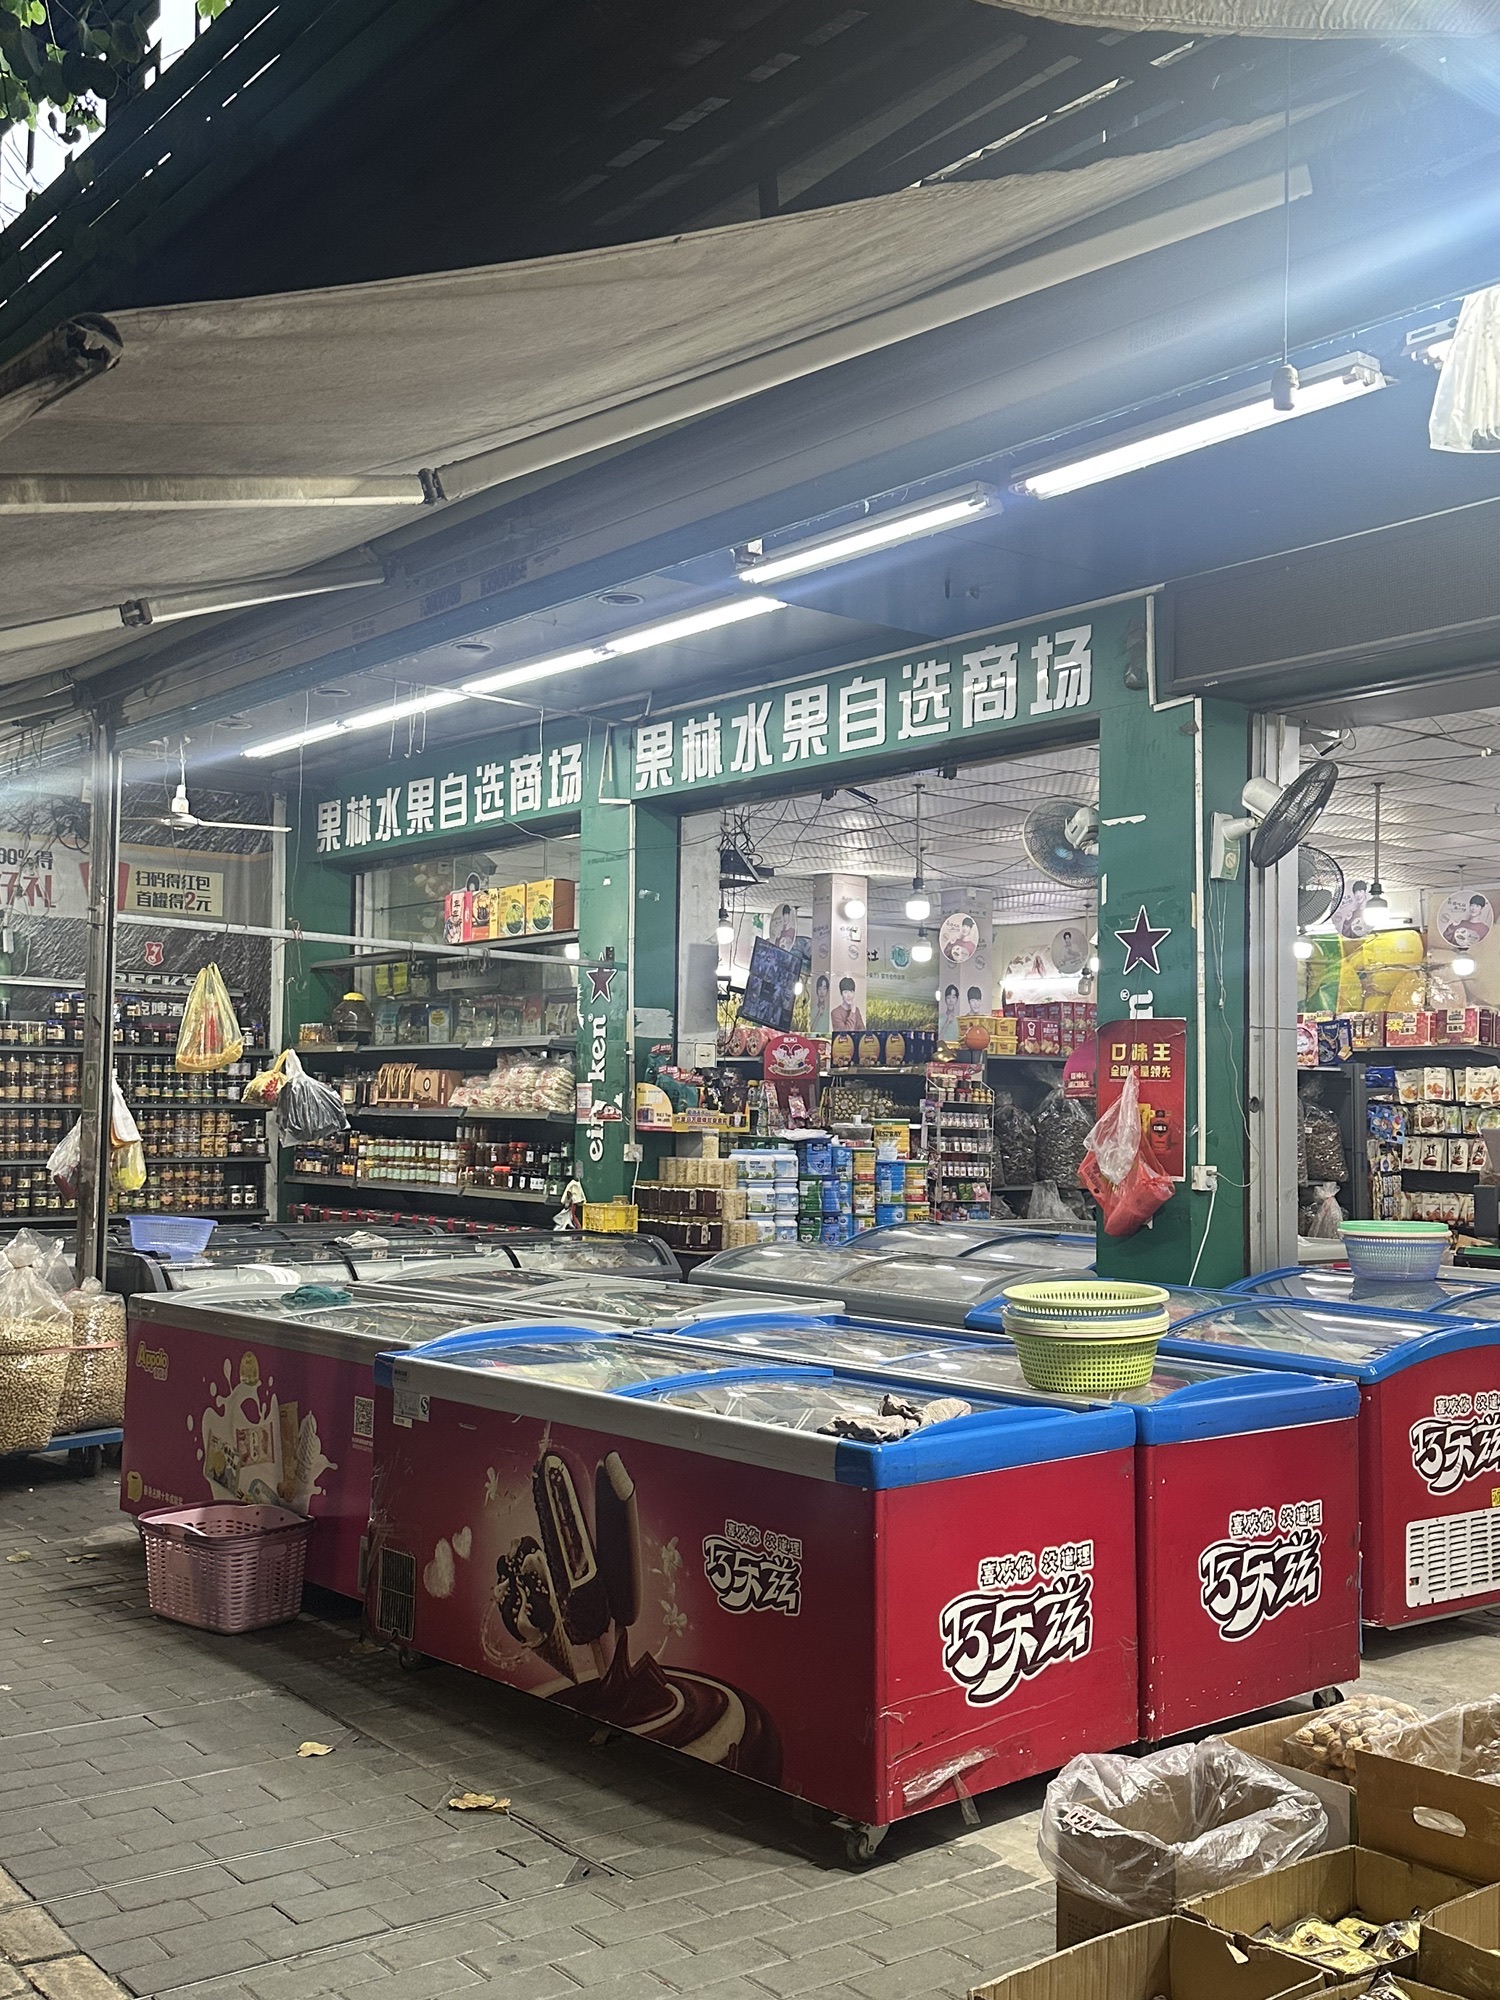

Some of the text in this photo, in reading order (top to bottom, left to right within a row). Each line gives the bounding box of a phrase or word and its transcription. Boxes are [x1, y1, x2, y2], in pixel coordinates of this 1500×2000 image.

[634, 623, 1095, 791] 果林水果自选商场
[317, 743, 583, 853] 果林水果自选商场
[135, 870, 211, 891] 扫码得红包
[136, 891, 212, 912] 首罐得2元
[1111, 1043, 1172, 1062] 口味王
[1110, 1065, 1172, 1079] 全国量领先
[136, 1342, 168, 1372] Appolo
[1436, 1394, 1500, 1415] 喜欢你 没道
[1411, 1415, 1500, 1492] 巧乐兹
[1231, 1502, 1321, 1537] 喜欢你 没道理
[725, 1521, 801, 1557] 喜欢你 没道理
[704, 1537, 800, 1614] 巧乐兹
[980, 1543, 1093, 1587] 喜欢你 没道理
[1201, 1529, 1320, 1638] 巧乐兹
[942, 1573, 1091, 1703] 巧乐兹
